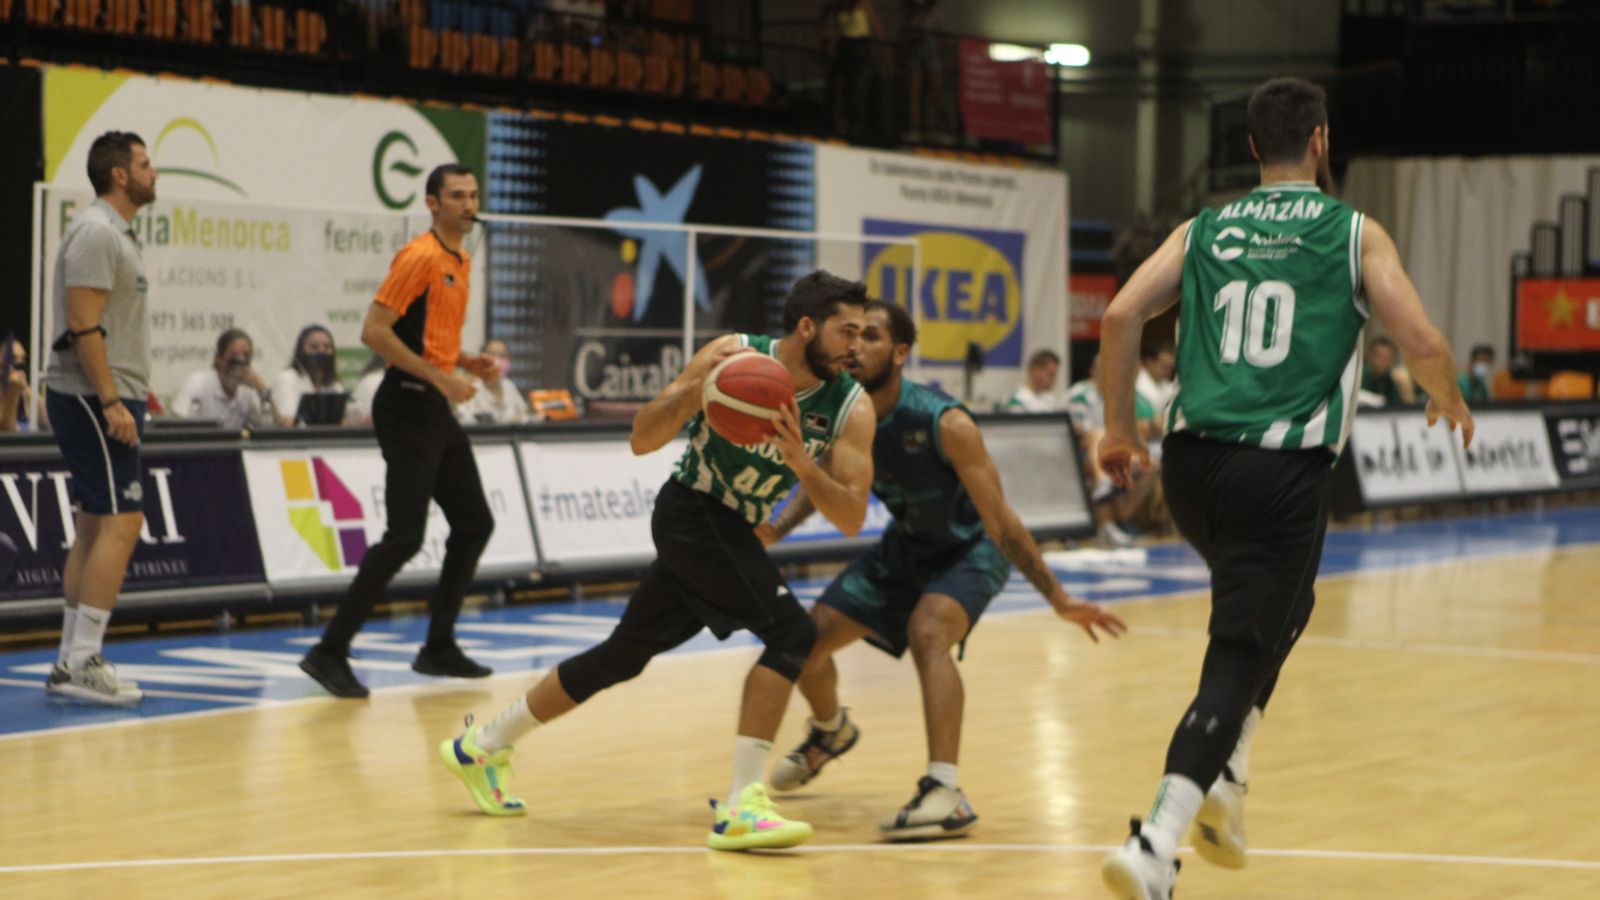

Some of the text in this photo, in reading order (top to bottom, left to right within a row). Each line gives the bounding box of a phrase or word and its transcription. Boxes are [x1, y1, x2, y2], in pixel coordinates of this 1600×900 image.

[881, 264, 1009, 324] IKEA
[1213, 280, 1296, 368] 10
[574, 341, 686, 399] CaixaB
